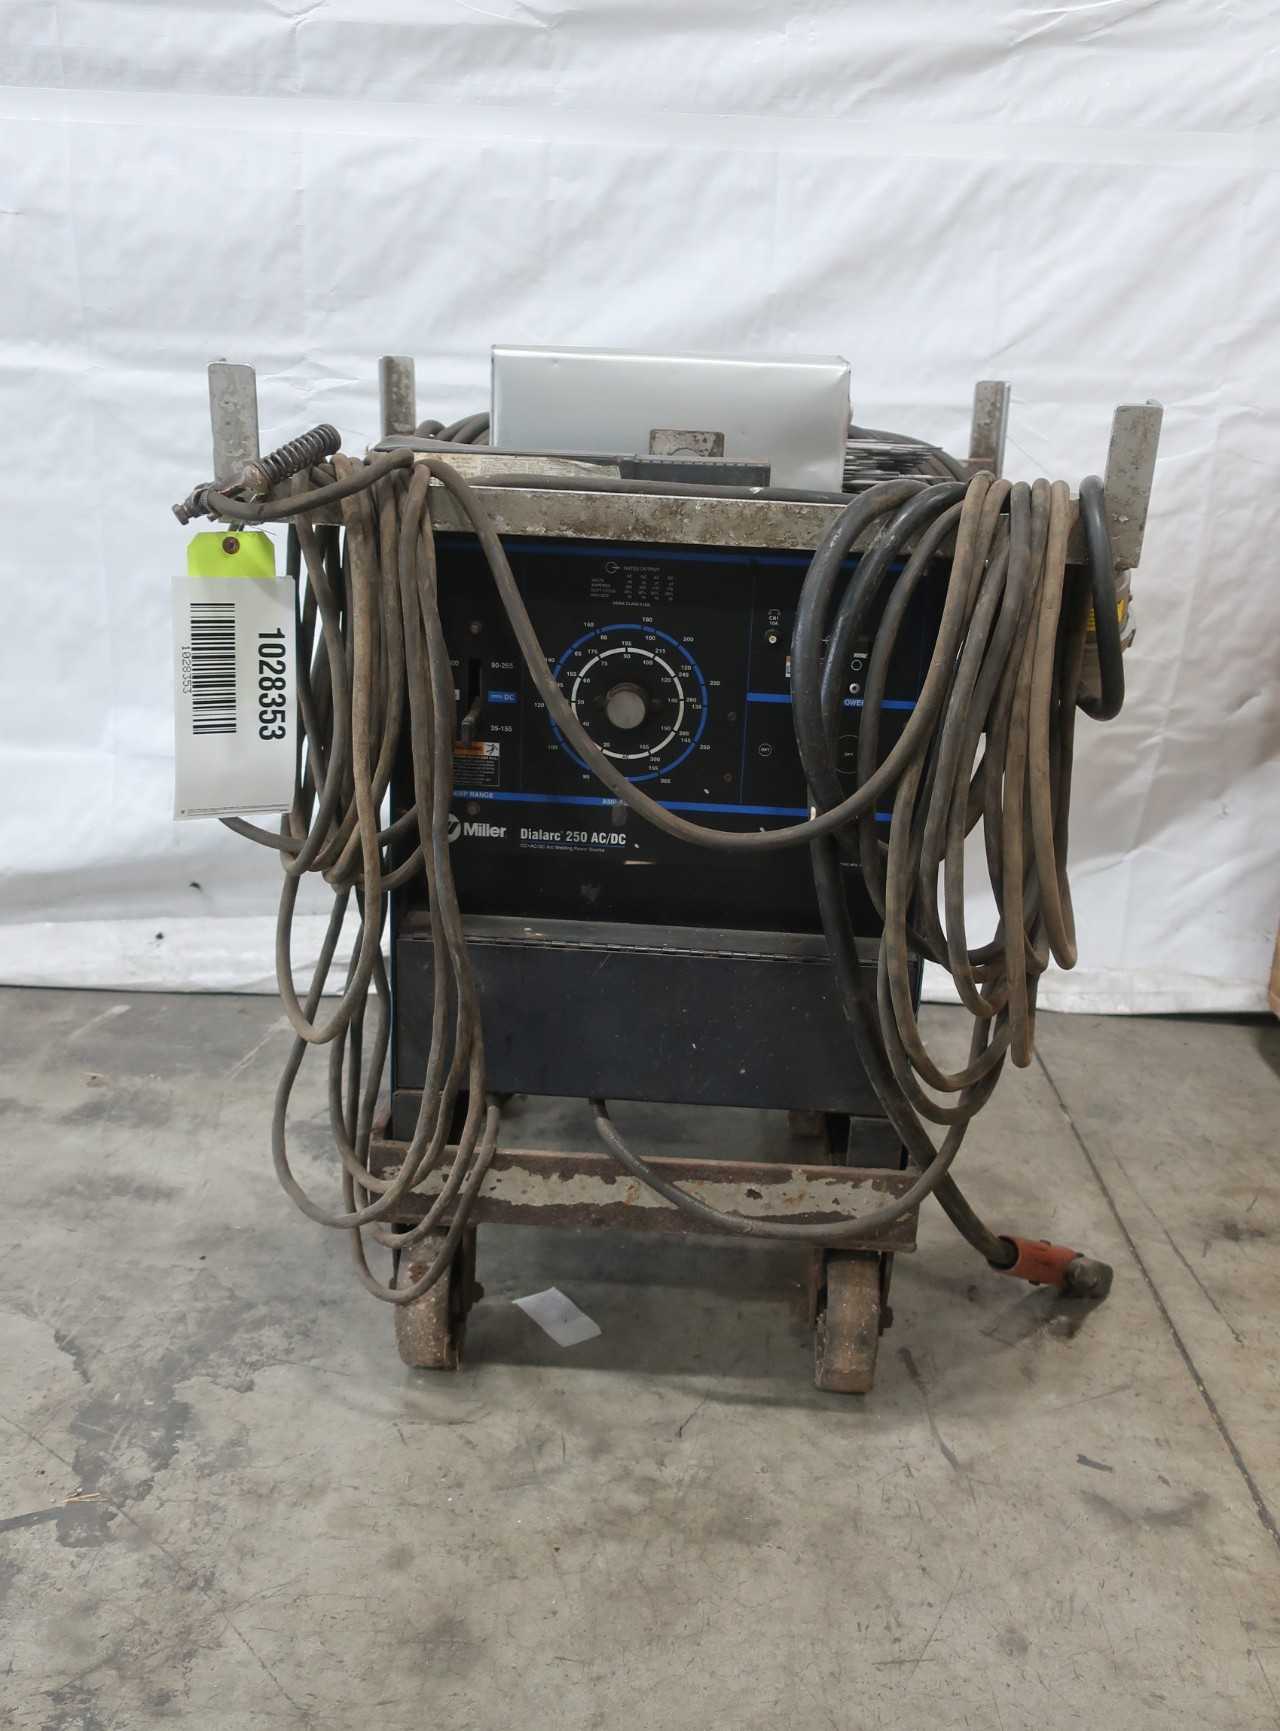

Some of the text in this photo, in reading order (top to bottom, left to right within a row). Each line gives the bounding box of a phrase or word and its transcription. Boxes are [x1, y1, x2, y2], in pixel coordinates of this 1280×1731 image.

[181, 645, 193, 695] 1028353
[258, 627, 287, 741] 1028353
[469, 791, 495, 799] RANGE
[463, 822, 507, 838] Miller
[520, 828, 627, 845] Dialarc 250 AC/DC
